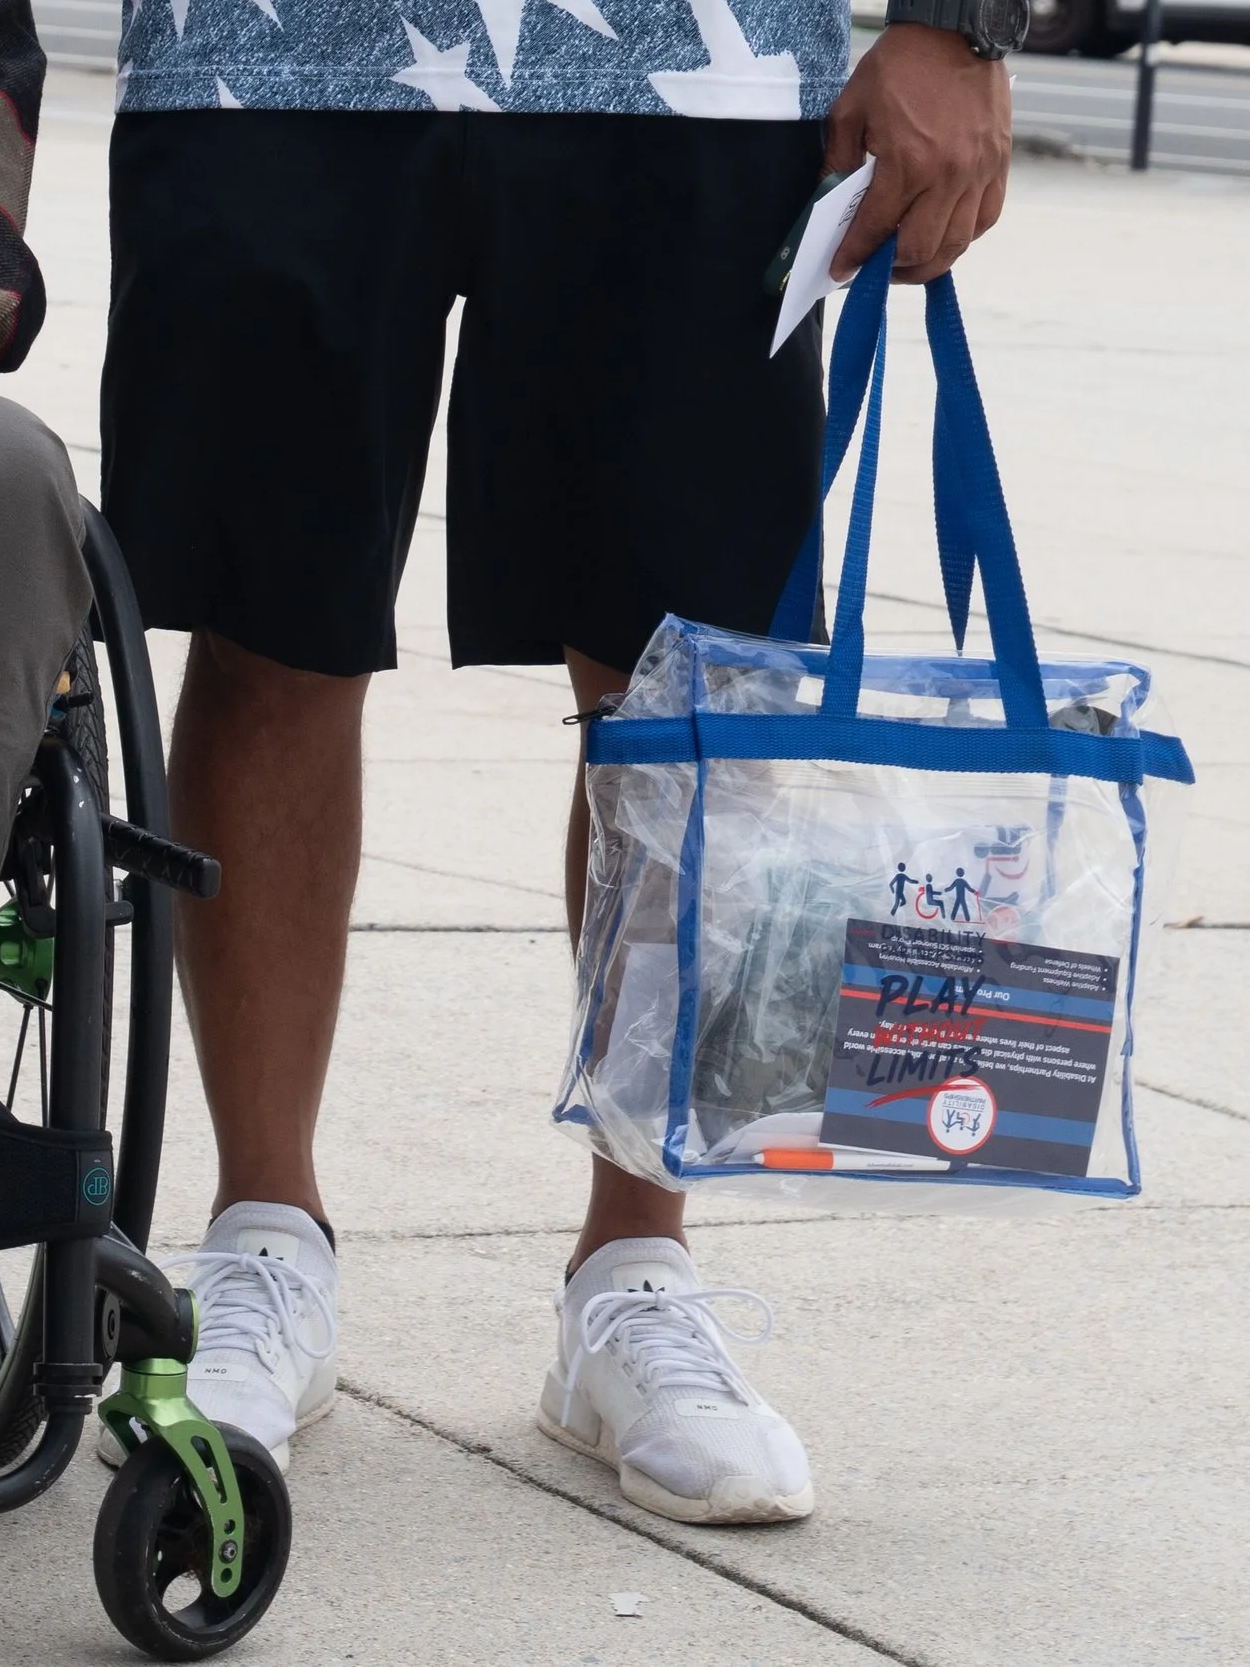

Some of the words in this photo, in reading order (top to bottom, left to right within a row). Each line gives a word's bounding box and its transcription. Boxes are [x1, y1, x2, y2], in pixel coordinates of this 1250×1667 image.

[878, 953, 906, 963] Housing
[906, 957, 940, 967] Accessible
[940, 963, 974, 973] Affordable
[1010, 962, 1037, 974] Funding
[1044, 958, 1070, 969] Defense
[1078, 964, 1101, 973] Wheels
[1037, 967, 1072, 978] Equipment
[1072, 972, 1101, 982] Adaptive
[1042, 976, 1071, 987] Wellness
[1072, 981, 1100, 992] Adaptive
[875, 974, 987, 1018] PLAY
[994, 991, 1010, 1001] Our
[847, 1028, 869, 1039] every
[873, 1016, 989, 1049] WITHOUT
[843, 1041, 865, 1051] world
[999, 1038, 1017, 1048] lives
[1018, 1040, 1035, 1050] their
[1046, 1044, 1070, 1054] aspect
[993, 1050, 1026, 1061] physical
[1026, 1054, 1042, 1064] with
[866, 1045, 982, 1087] LIMITS
[995, 1062, 1006, 1070] we
[1043, 1056, 1073, 1068] persons
[1073, 1061, 1096, 1071] where
[1052, 1068, 1087, 1082] Disability
